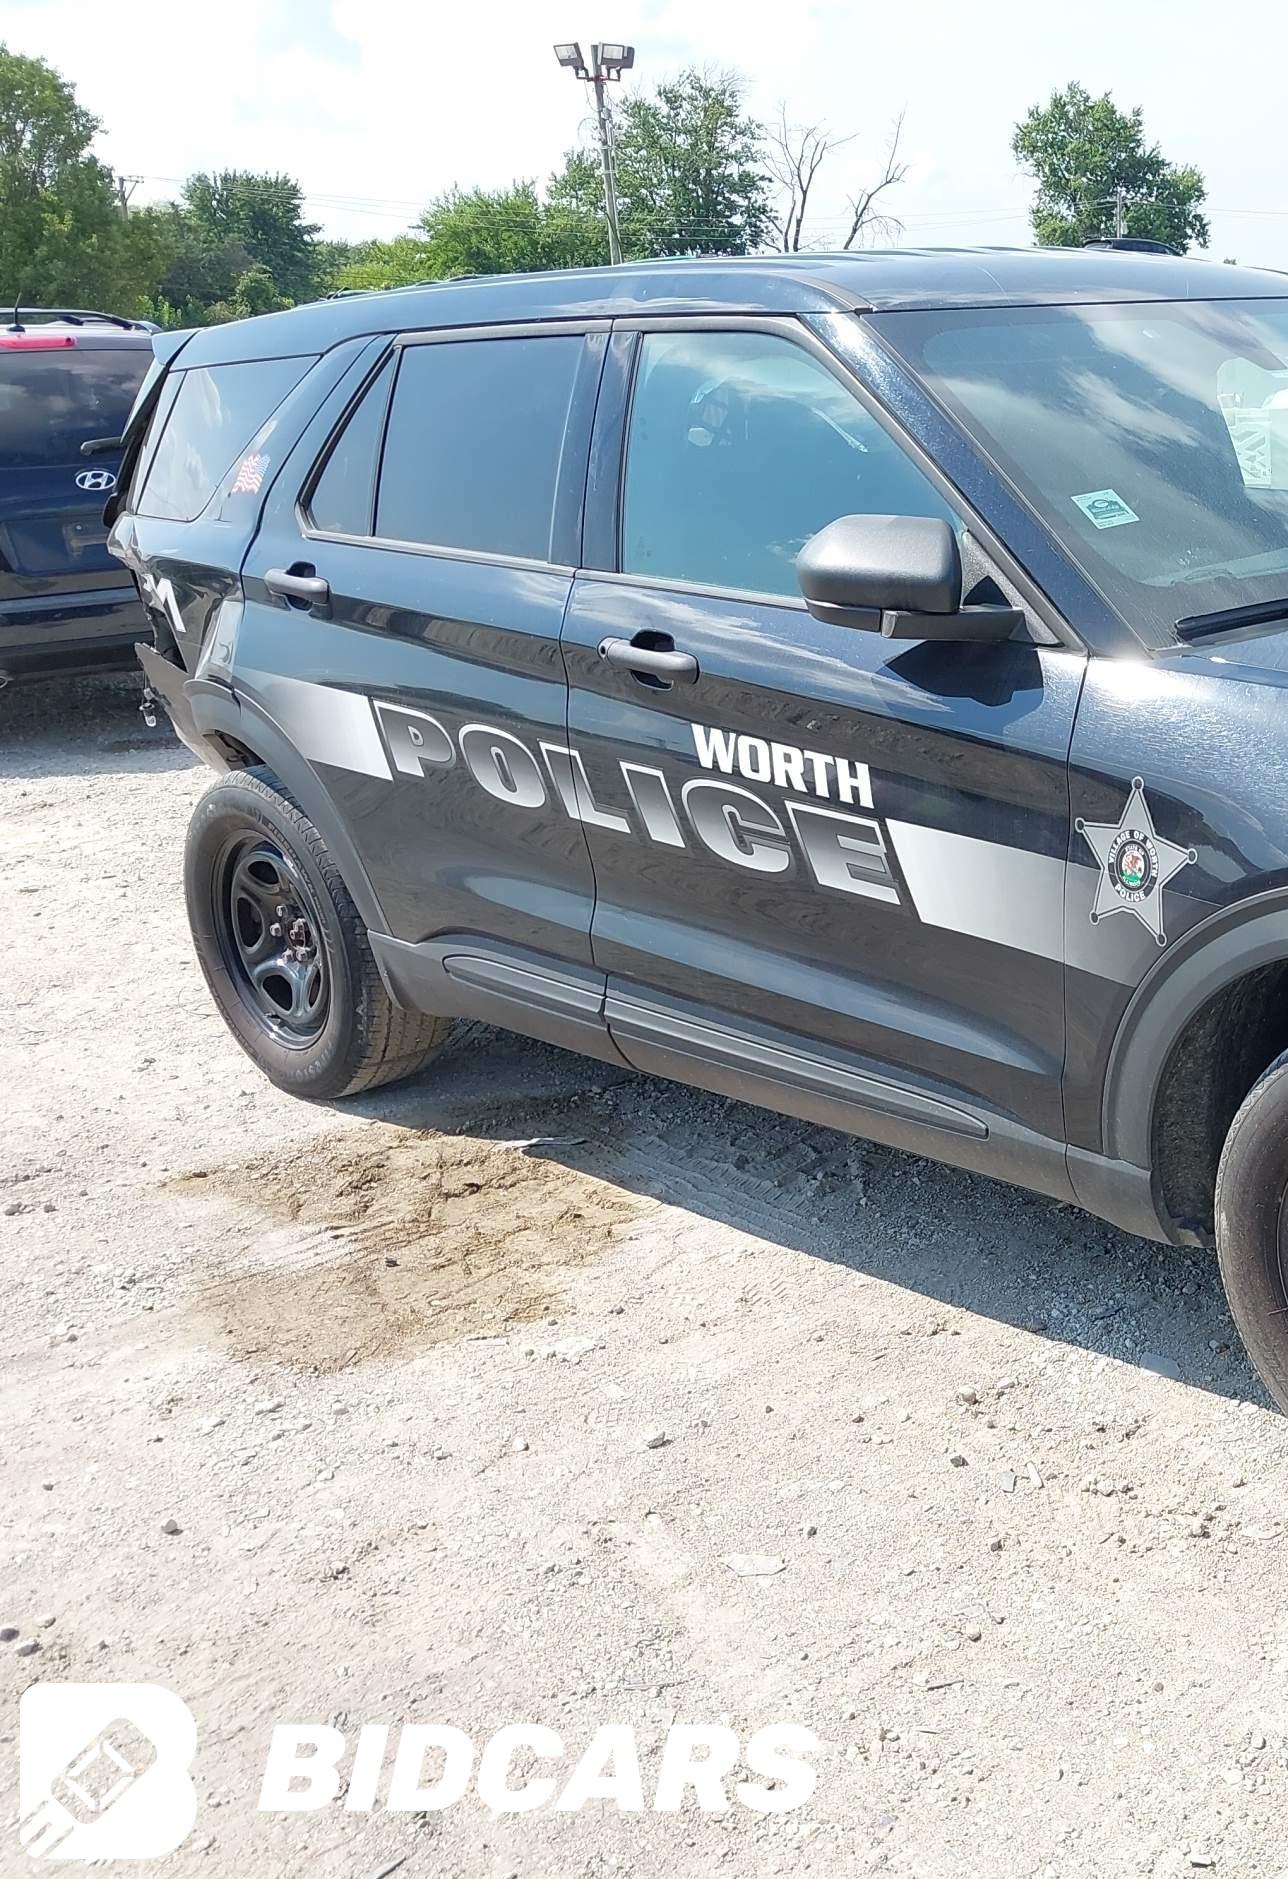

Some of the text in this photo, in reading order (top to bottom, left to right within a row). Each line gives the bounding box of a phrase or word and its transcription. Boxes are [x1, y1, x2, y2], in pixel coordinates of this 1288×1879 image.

[690, 722, 875, 808] WORTH
[372, 698, 902, 906] POLICE
[1109, 830, 1159, 877] VILLAGE OF WORTH
[1115, 883, 1146, 902] POLICE
